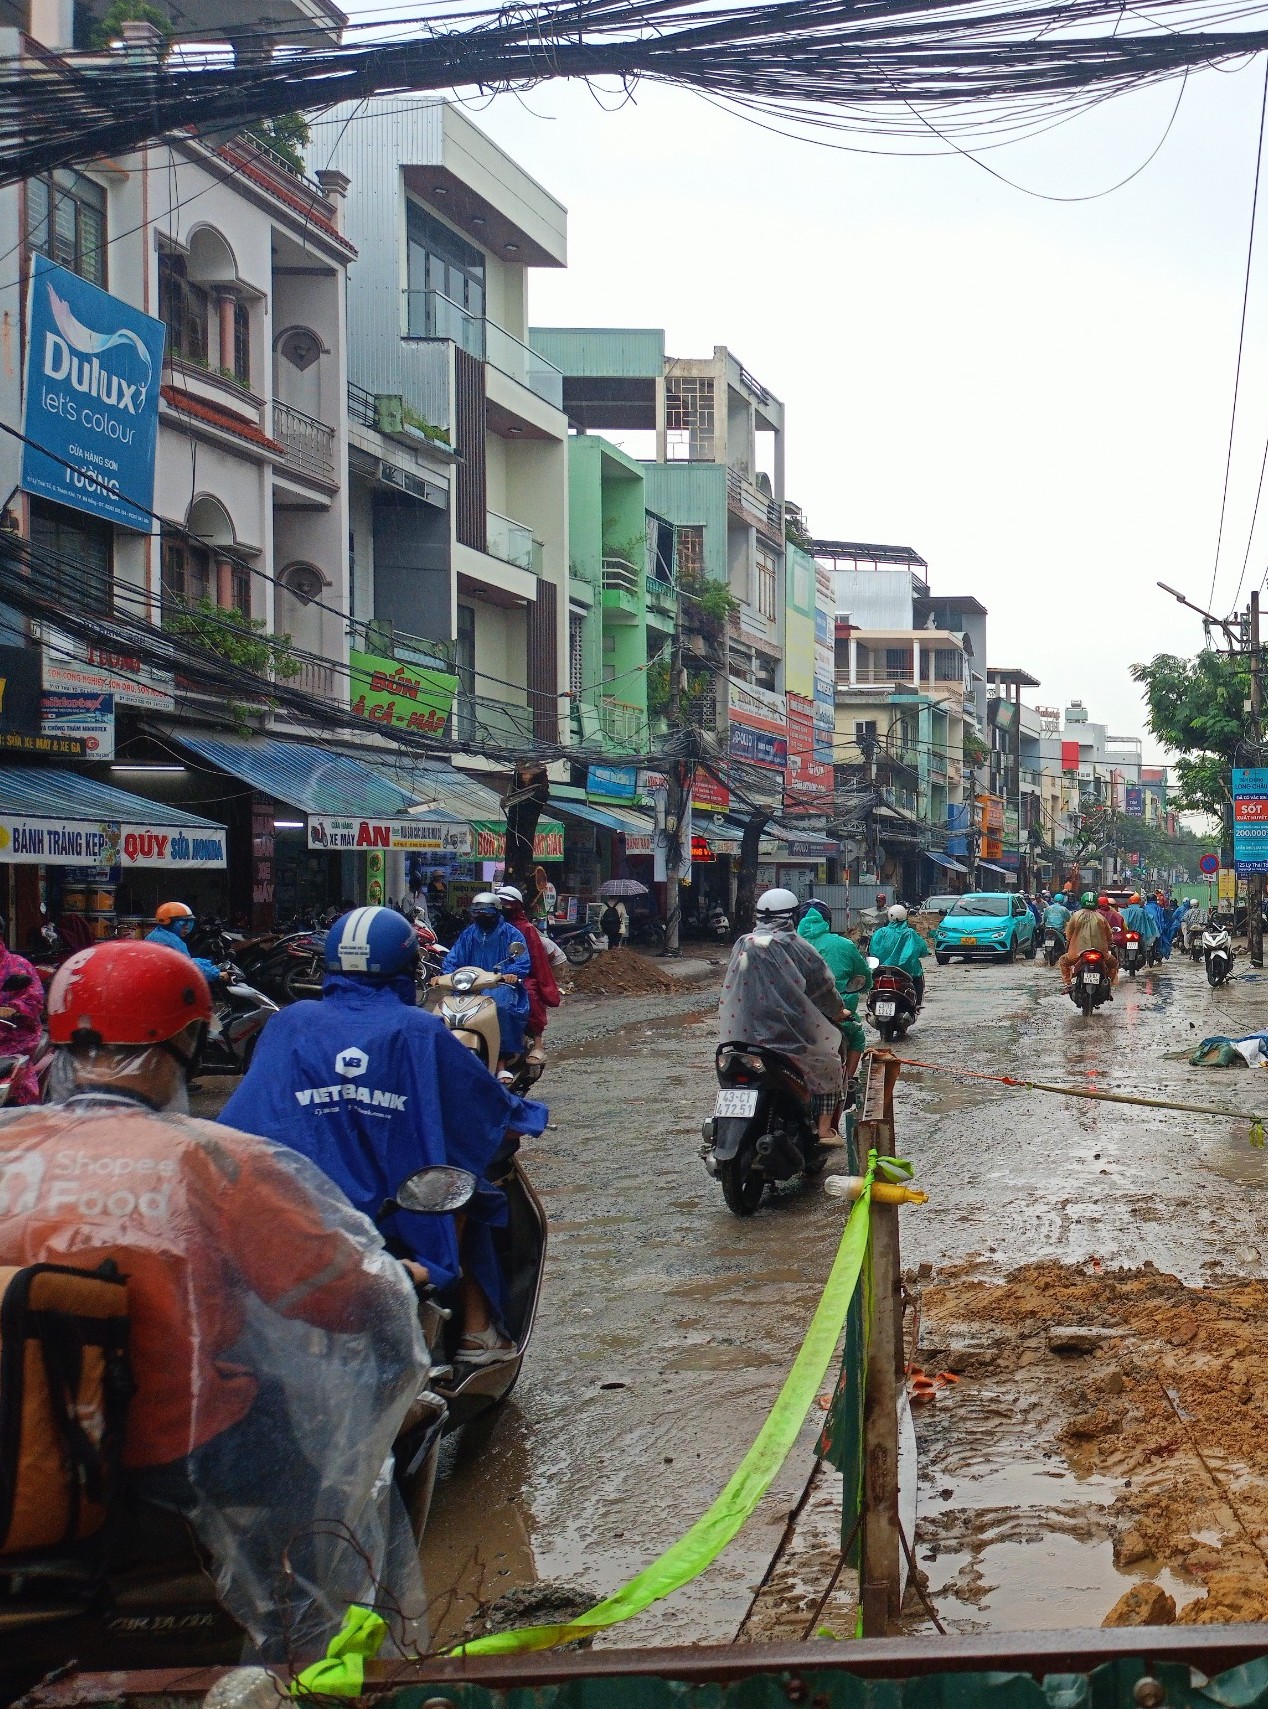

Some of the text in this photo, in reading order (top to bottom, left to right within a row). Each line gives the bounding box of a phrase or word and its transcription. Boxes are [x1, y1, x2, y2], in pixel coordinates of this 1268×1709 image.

[44, 331, 136, 415] Dulux
[42, 386, 135, 445] let's colour
[84, 449, 104, 466] HÀNG
[104, 458, 118, 472] SƠN
[24, 736, 33, 748] XE
[60, 739, 69, 751] XE
[71, 741, 81, 753] GA
[1241, 802, 1263, 814] SỐT
[13, 823, 44, 854] BÁNH
[47, 826, 82, 856] TRÁNG
[329, 833, 339, 847] XE
[340, 832, 356, 847] MÁY
[295, 1084, 408, 1111] VIETBANK
[723, 1091, 750, 1103] 43-C1
[717, 1104, 752, 1116] 472.51
[55, 1151, 177, 1176] Shopee
[50, 1180, 173, 1217] Food
